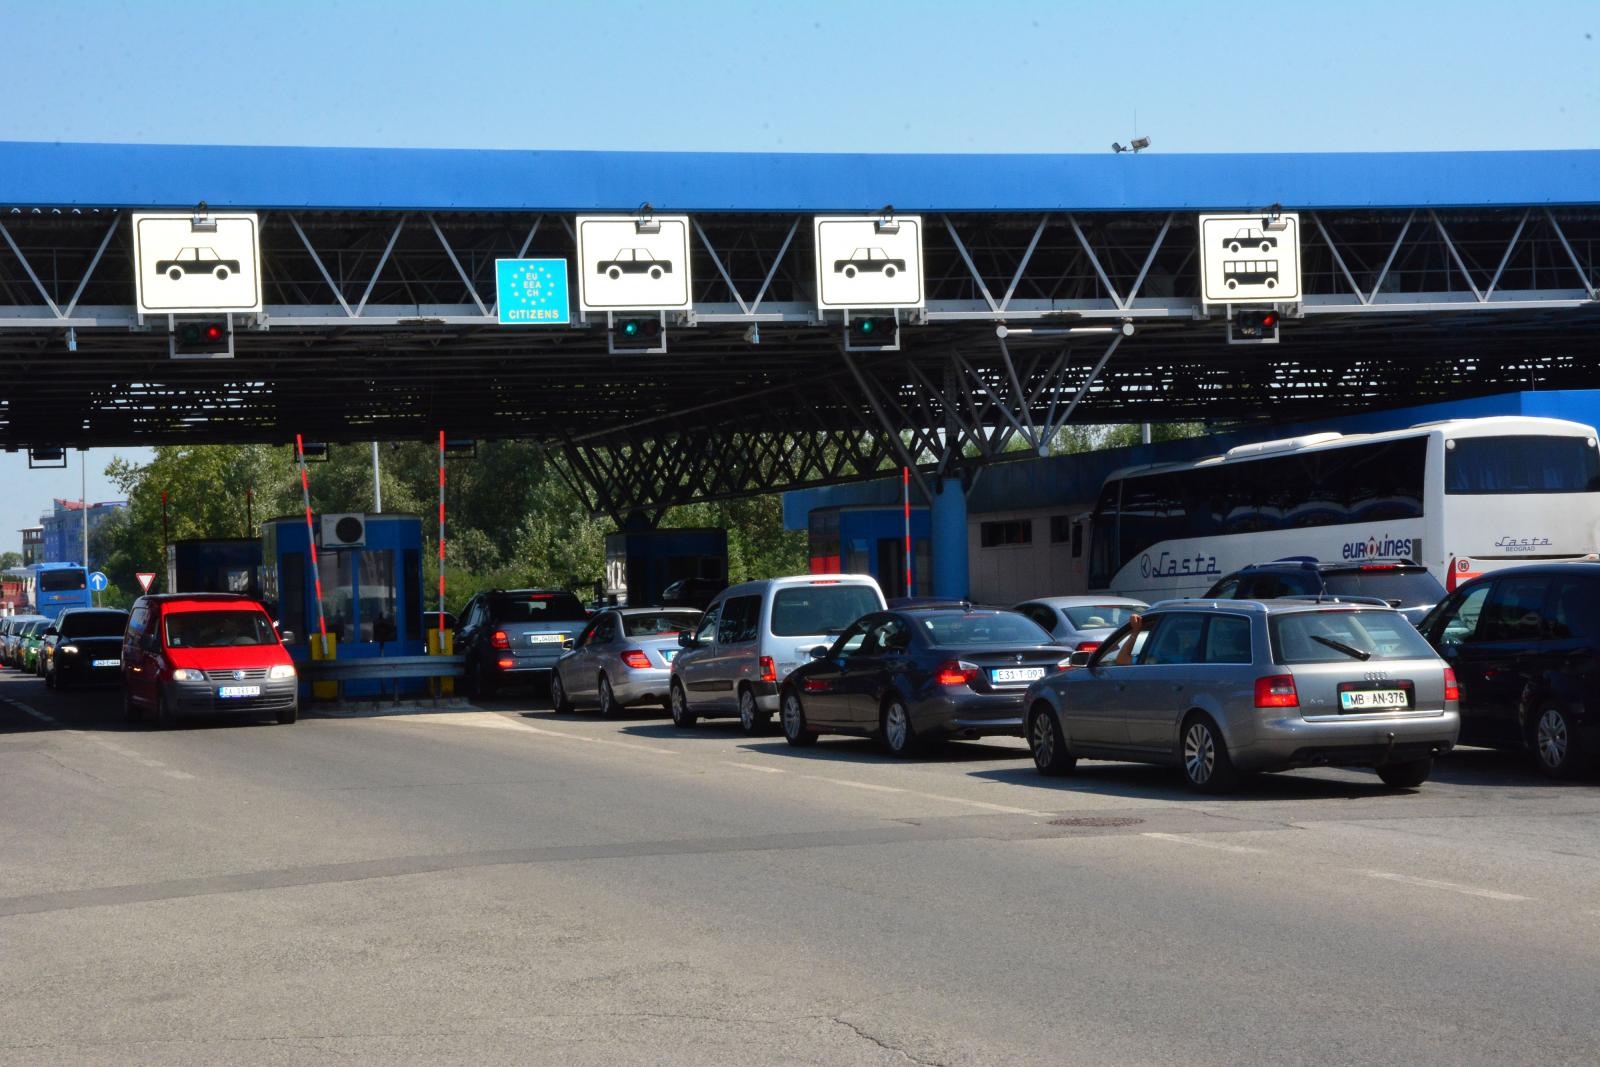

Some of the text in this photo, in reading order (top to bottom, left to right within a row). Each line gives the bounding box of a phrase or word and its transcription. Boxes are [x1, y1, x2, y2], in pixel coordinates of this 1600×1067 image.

[508, 310, 559, 319] CITIZENS
[1494, 536, 1552, 547] Lasta
[1153, 552, 1221, 577] Lasta
[1350, 692, 1405, 705] MB AN-376
